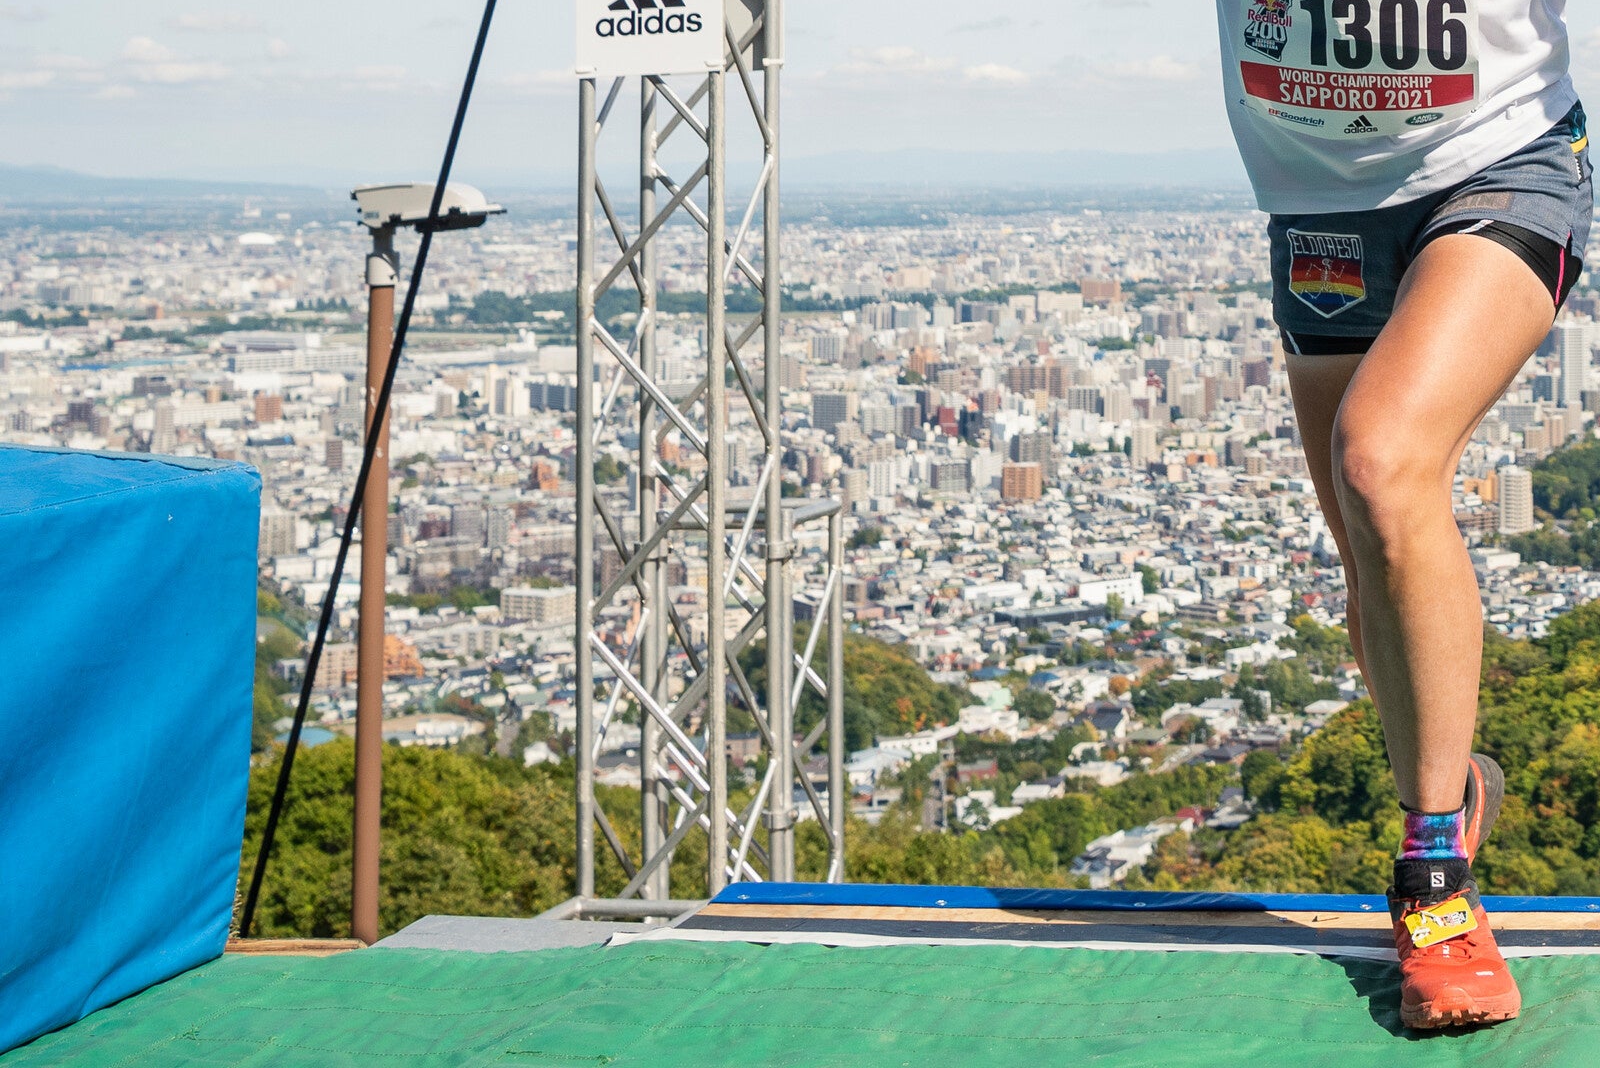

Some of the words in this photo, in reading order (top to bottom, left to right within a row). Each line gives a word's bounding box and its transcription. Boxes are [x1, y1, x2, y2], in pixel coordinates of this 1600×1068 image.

[595, 8, 703, 38] adidas
[1247, 8, 1269, 23] Red
[1271, 13, 1292, 28] Bull
[1279, 68, 1326, 86] WORLD
[1330, 73, 1433, 89] CHAMPIONSHIP
[1279, 83, 1377, 110] SAPPORO
[1385, 89, 1433, 110] 2021
[1268, 107, 1325, 126] BFGoodrich
[1343, 122, 1379, 134] adidas
